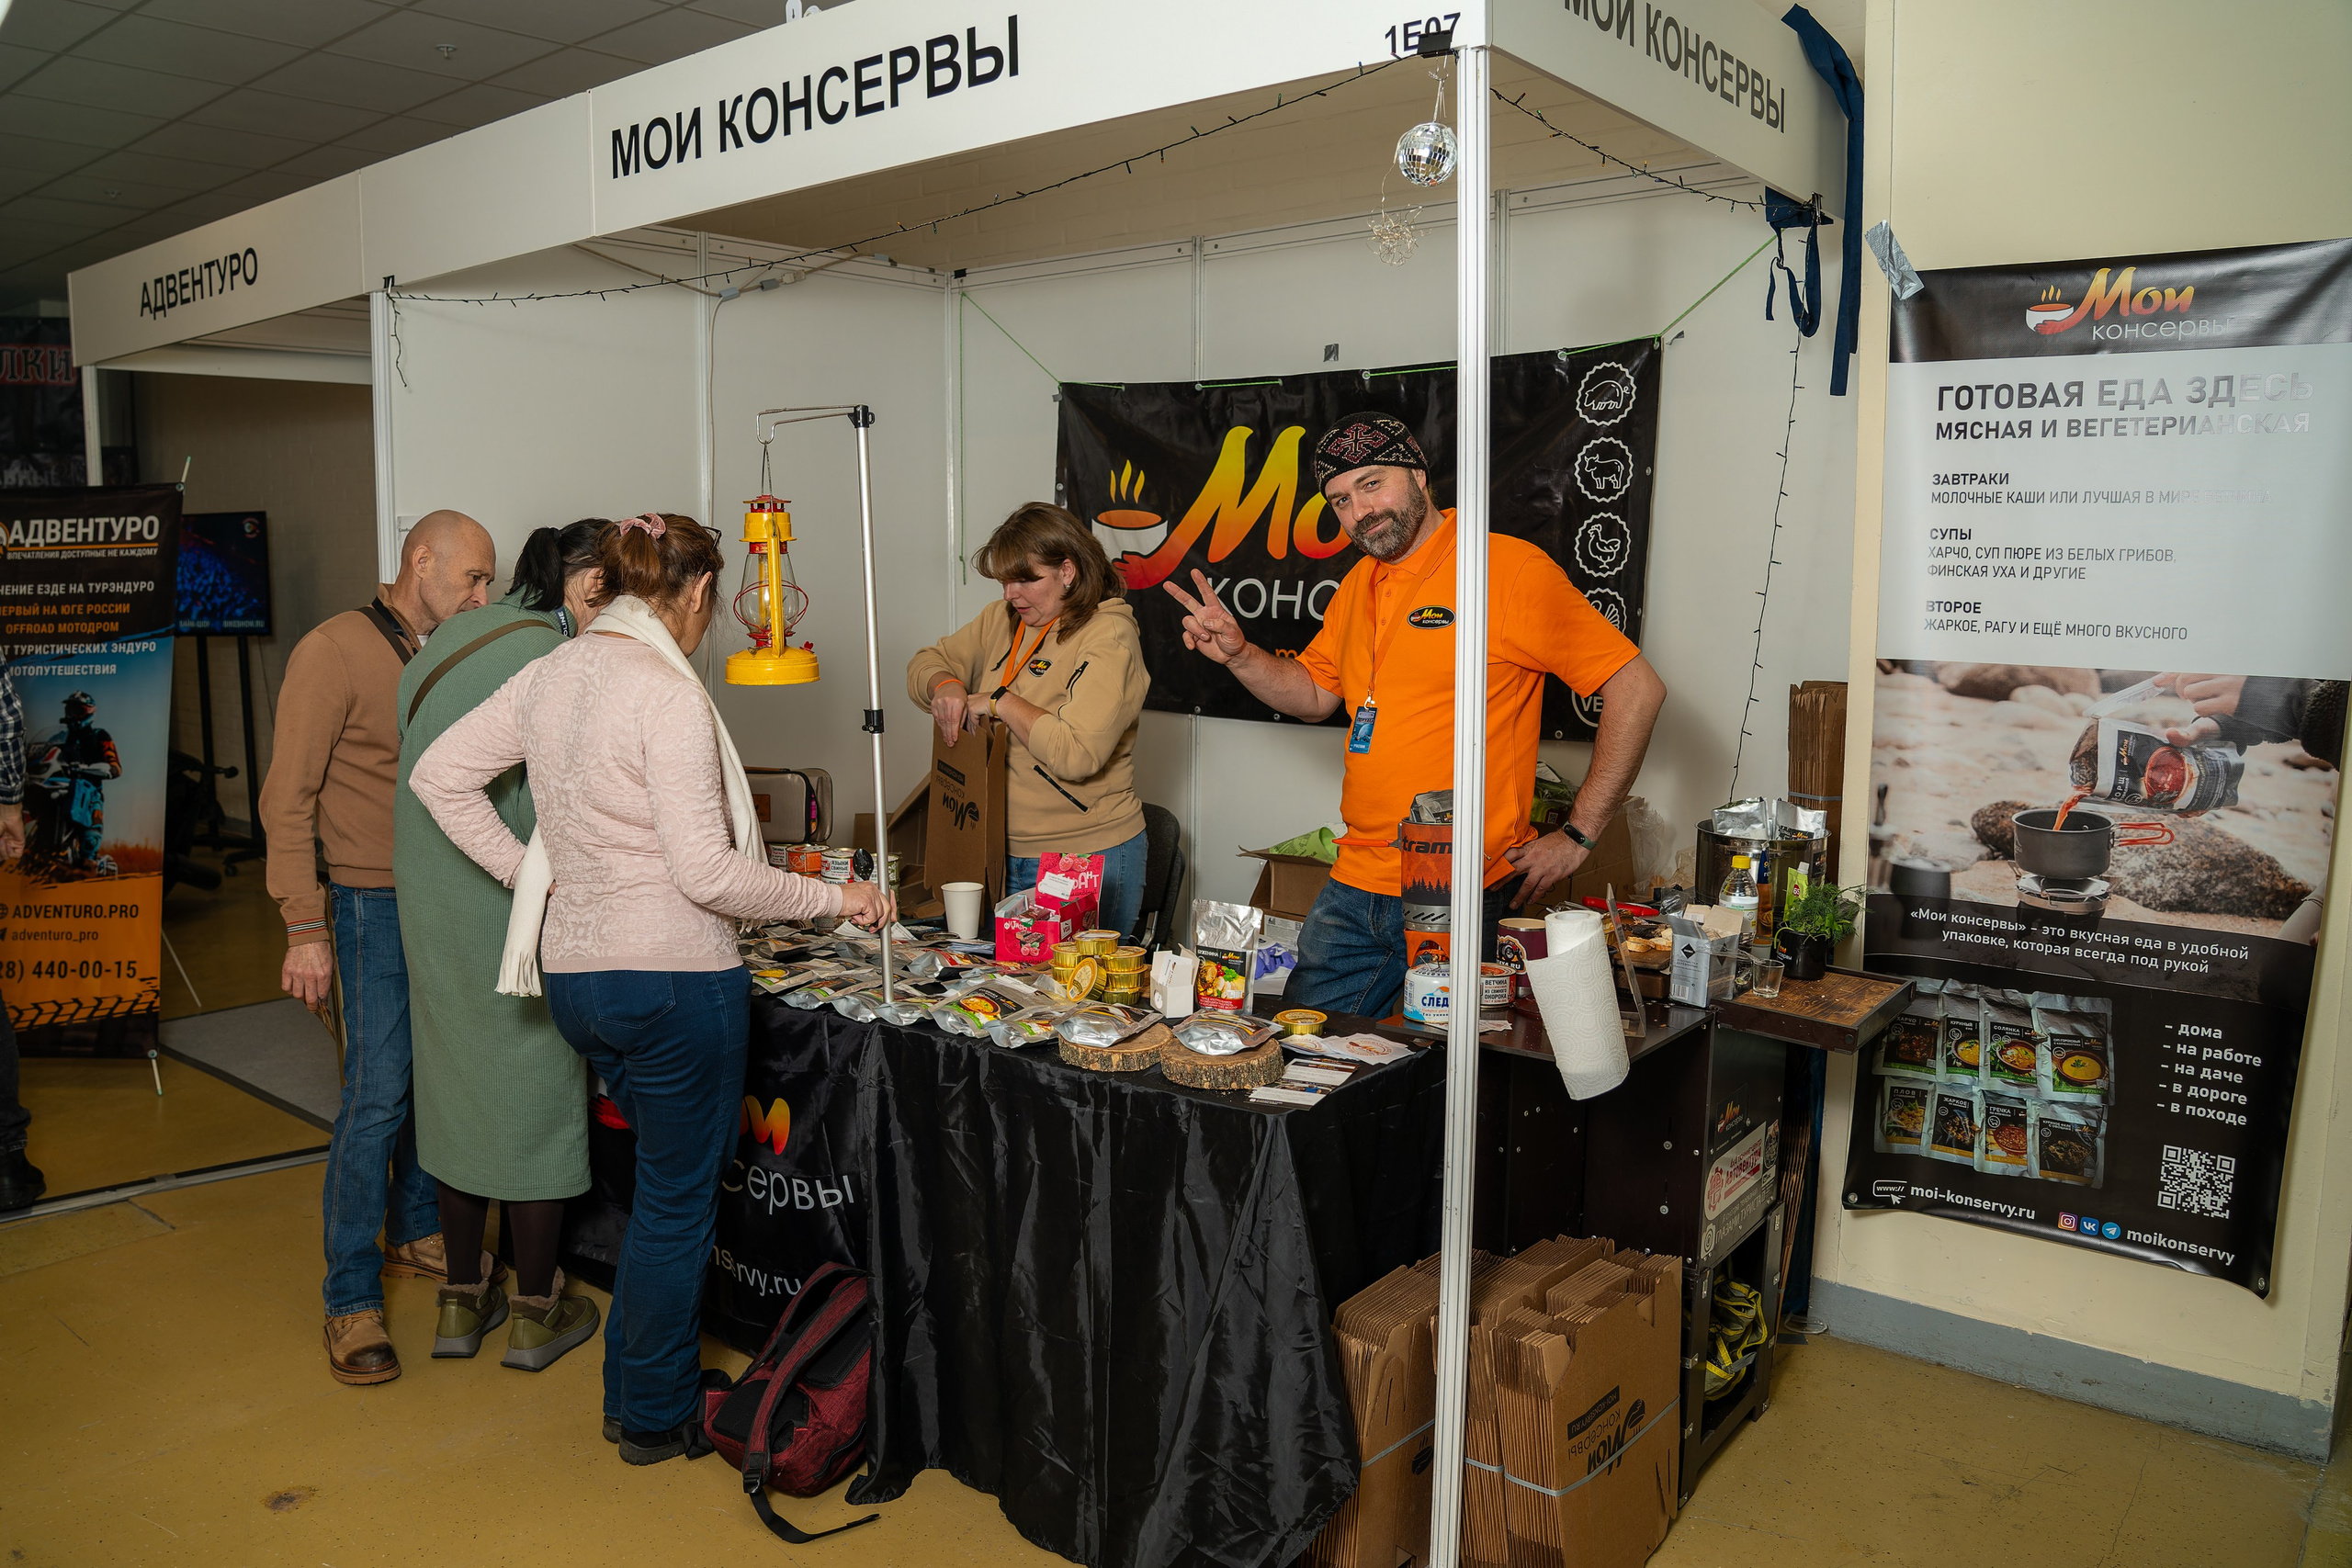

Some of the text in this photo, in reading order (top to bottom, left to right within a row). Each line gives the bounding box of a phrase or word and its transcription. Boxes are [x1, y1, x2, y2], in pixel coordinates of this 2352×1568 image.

[1565, 0, 1785, 133] ОИ КОНСЕРВЫ
[612, 14, 1019, 179] МОИ КОНСЕРВЫ
[140, 247, 258, 321] АДВЕНТУРО
[2084, 266, 2195, 321] Мои
[2091, 317, 2230, 342] консервы
[1938, 372, 2314, 412] ГОТОВАЯ ЕДА ЗДЕСЬ
[1936, 412, 2311, 441] МЯСНАЯ И ВЕГЕТЕРИАНСКАЯ
[1932, 473, 2009, 486] ЗАВТРАКИ
[1931, 491, 2003, 504] МОЛОЧНЫЕ
[2007, 491, 2045, 504] КАШИ
[2050, 491, 2078, 504] ИЛИ
[2082, 491, 2141, 506] ЛУЧШАЯ
[2145, 491, 2154, 504] В
[2158, 491, 2200, 504] МИРЕ
[9, 515, 160, 547] АДВЕНТУРО
[1929, 528, 1972, 541] СУПЫ
[7, 548, 158, 560] ВПЕЧАТЛЕНИЯ ДОСТУПНЫЕ НЕ КАЖДОМУ
[1928, 547, 2177, 564] ХАРЧО, СУП ПЮРЕ ИЗ БЕЛЫХ ГРИБОВ,
[1927, 563, 2086, 581] ФИНСКАЯ УХА И ДРУГИЕ
[37, 583, 65, 596] ЕЗДЕ
[69, 582, 84, 594] НА
[87, 581, 154, 594] ТУРЭНДУРО
[43, 605, 57, 615] НА
[61, 604, 84, 615] ЮГЕ
[87, 604, 130, 615] РОССИИ
[1926, 601, 1982, 614] ВТОРОЕ
[6, 622, 119, 635] OFFROAD МОТОДРОМ
[1924, 618, 2188, 640] ЖАРКОЕ, РАГУ И ЕЩЁ МНОГО ВКУСНОГО
[14, 641, 157, 656] ТУРИСТИЧЕСКИХ ЭНДУРО
[942, 791, 967, 831] Мои
[1402, 836, 1452, 854] tram
[12, 904, 139, 919] ADVENTURO.PRO
[11, 929, 99, 942] adventuro_pro
[1910, 907, 1947, 922] «Мои
[1951, 914, 2026, 932] консервы»
[2041, 925, 2065, 938] это
[2070, 928, 2130, 946] вкусная
[2134, 936, 2162, 952] еда
[2166, 941, 2177, 952] в
[2180, 940, 2249, 961] удобной
[1941, 929, 2210, 975] упаковке, которая всегда под рукой
[32, 960, 138, 979] 440-00-15
[1993, 1024, 2020, 1033] СОЛЯНКА
[2177, 1023, 2222, 1039] дома
[2177, 1043, 2197, 1056] на
[2202, 1047, 2262, 1067] работе
[2174, 1063, 2195, 1076] на
[2199, 1067, 2244, 1084] даче
[2172, 1083, 2182, 1094] в
[2187, 1085, 2247, 1105] дороге
[1989, 1106, 2011, 1114] ГРЕЧКА
[2170, 1102, 2180, 1113] в
[2186, 1105, 2247, 1126] походе
[1911, 1184, 2036, 1220] moi-konservy.ru
[2126, 1227, 2235, 1266] moikonservy
[1567, 1408, 1621, 1461] консервы
